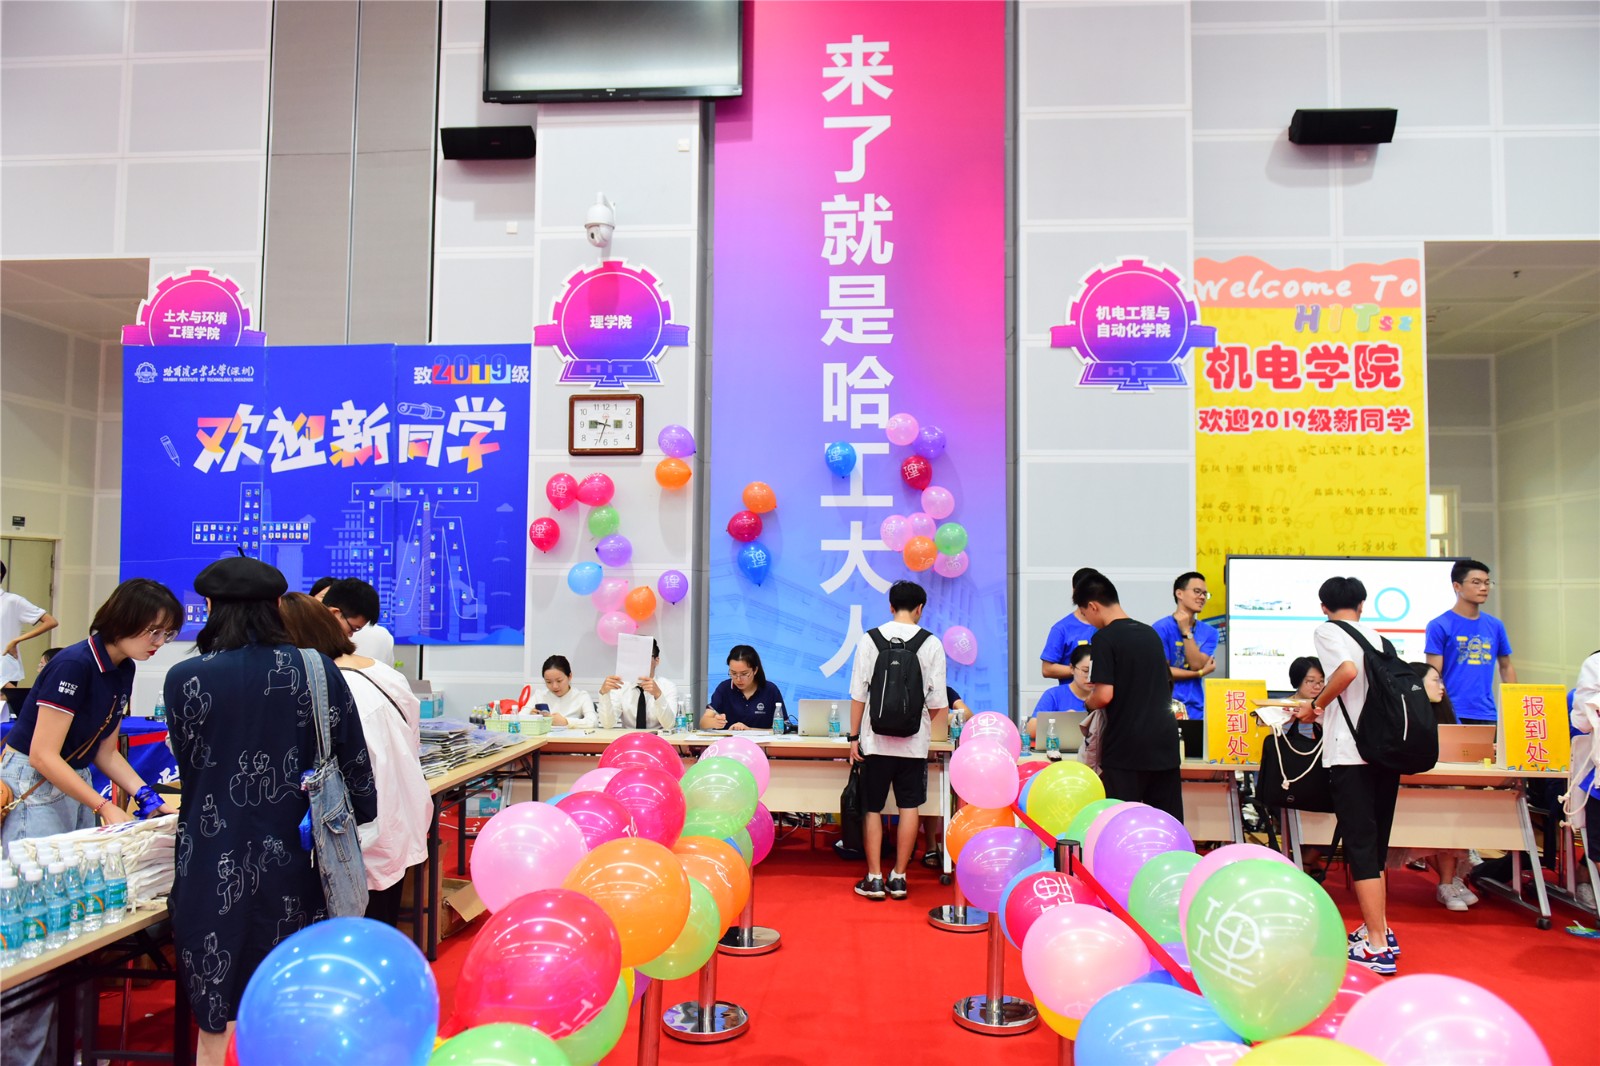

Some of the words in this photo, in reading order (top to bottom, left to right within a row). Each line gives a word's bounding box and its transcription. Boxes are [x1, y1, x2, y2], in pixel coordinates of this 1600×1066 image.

[1370, 274, 1418, 301] To
[162, 309, 228, 325] 土木与环境
[1096, 305, 1171, 321] 机电工程与
[589, 314, 633, 329] 理学院
[168, 325, 220, 340] 工程学院
[1096, 322, 1171, 338] 自动化学院
[413, 353, 530, 385] 致2019级
[585, 364, 633, 374] HIT
[1106, 366, 1158, 377] HIT
[1203, 343, 1403, 391] 机电学院
[580, 408, 588, 416] 10
[593, 403, 599, 411] 11
[602, 403, 610, 411] 12
[614, 403, 618, 411] 1
[625, 408, 631, 416] 2
[628, 421, 633, 429] 3
[1198, 408, 1412, 433] 欢迎2019级新同学
[193, 395, 507, 474] 欢迎新同学
[594, 438, 599, 446] 7
[602, 438, 608, 446] 6
[613, 438, 618, 446] 5
[1225, 690, 1250, 757] 报到处
[1523, 695, 1550, 763] 报到处
